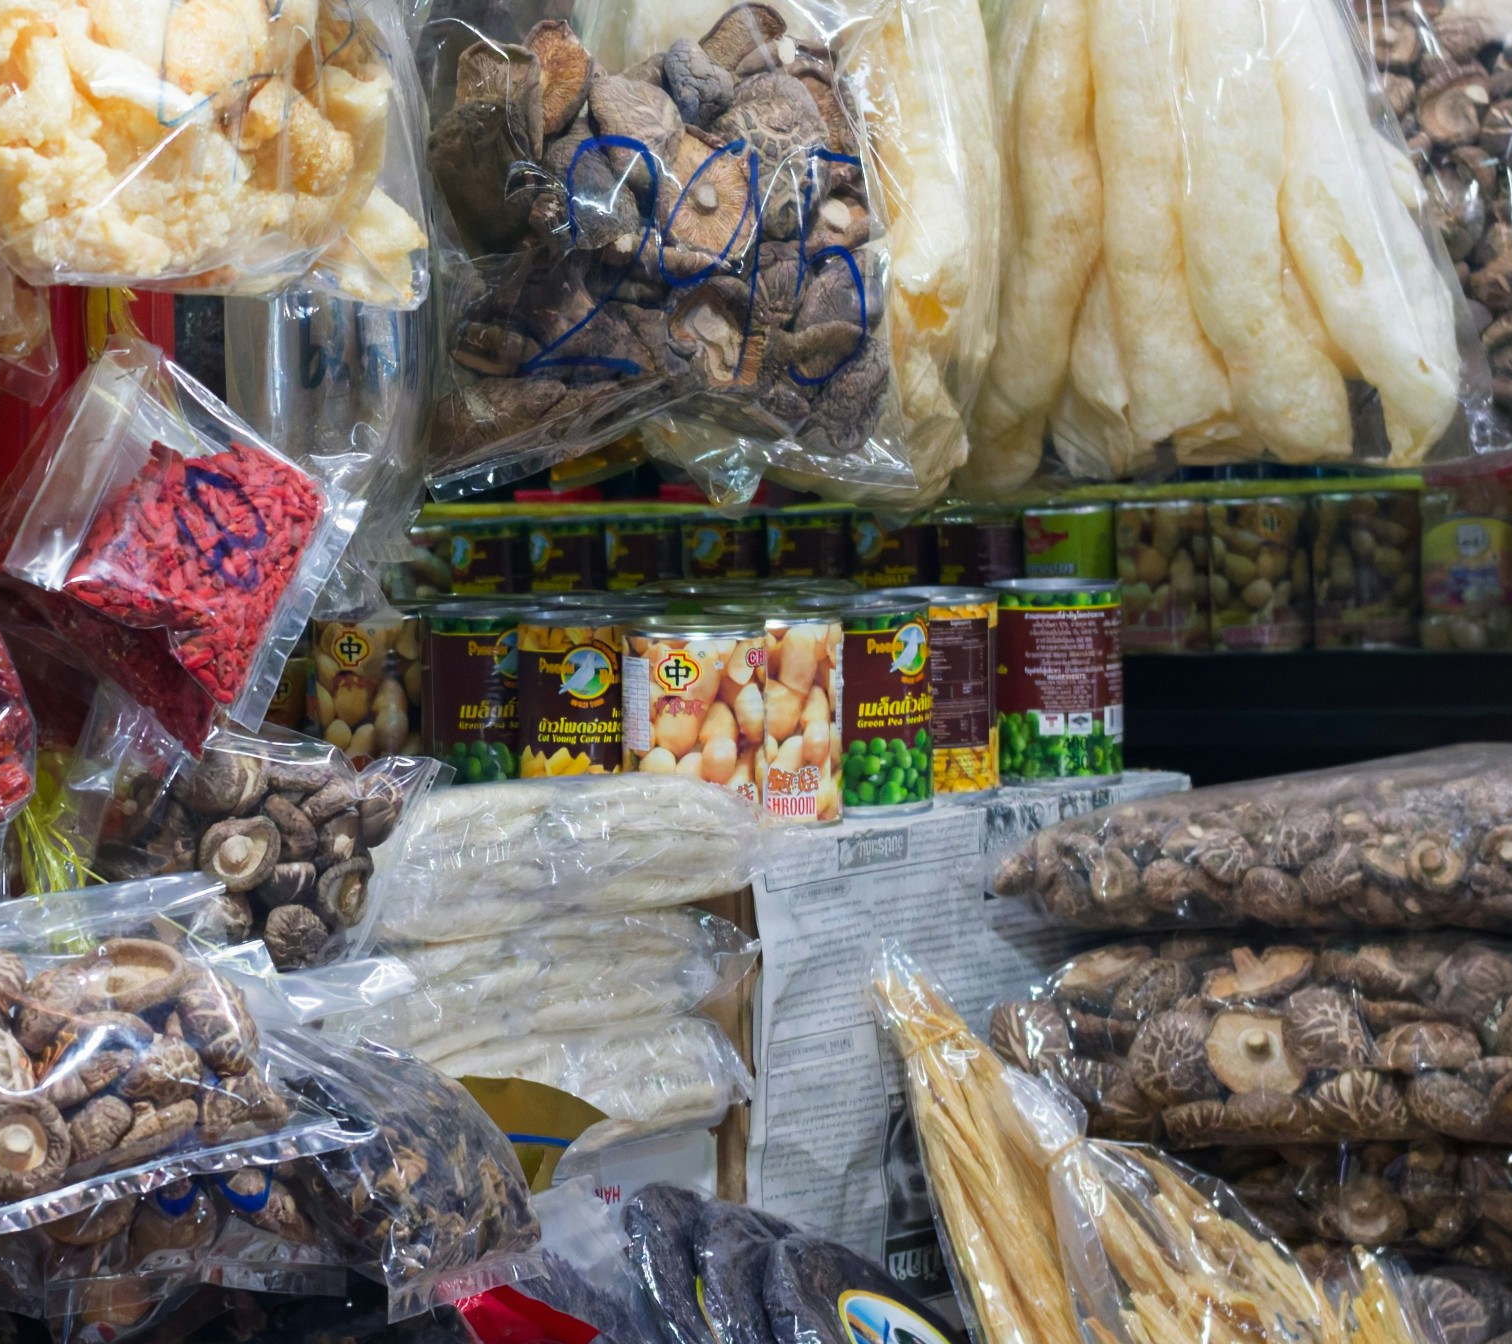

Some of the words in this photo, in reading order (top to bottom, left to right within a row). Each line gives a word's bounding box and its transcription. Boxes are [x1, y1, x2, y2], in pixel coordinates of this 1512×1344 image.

[339, 636, 363, 662] 中
[664, 658, 692, 687] 中
[857, 718, 884, 729] Green
[887, 717, 903, 727] Pea
[553, 735, 577, 745] Young
[580, 735, 601, 744] Corn
